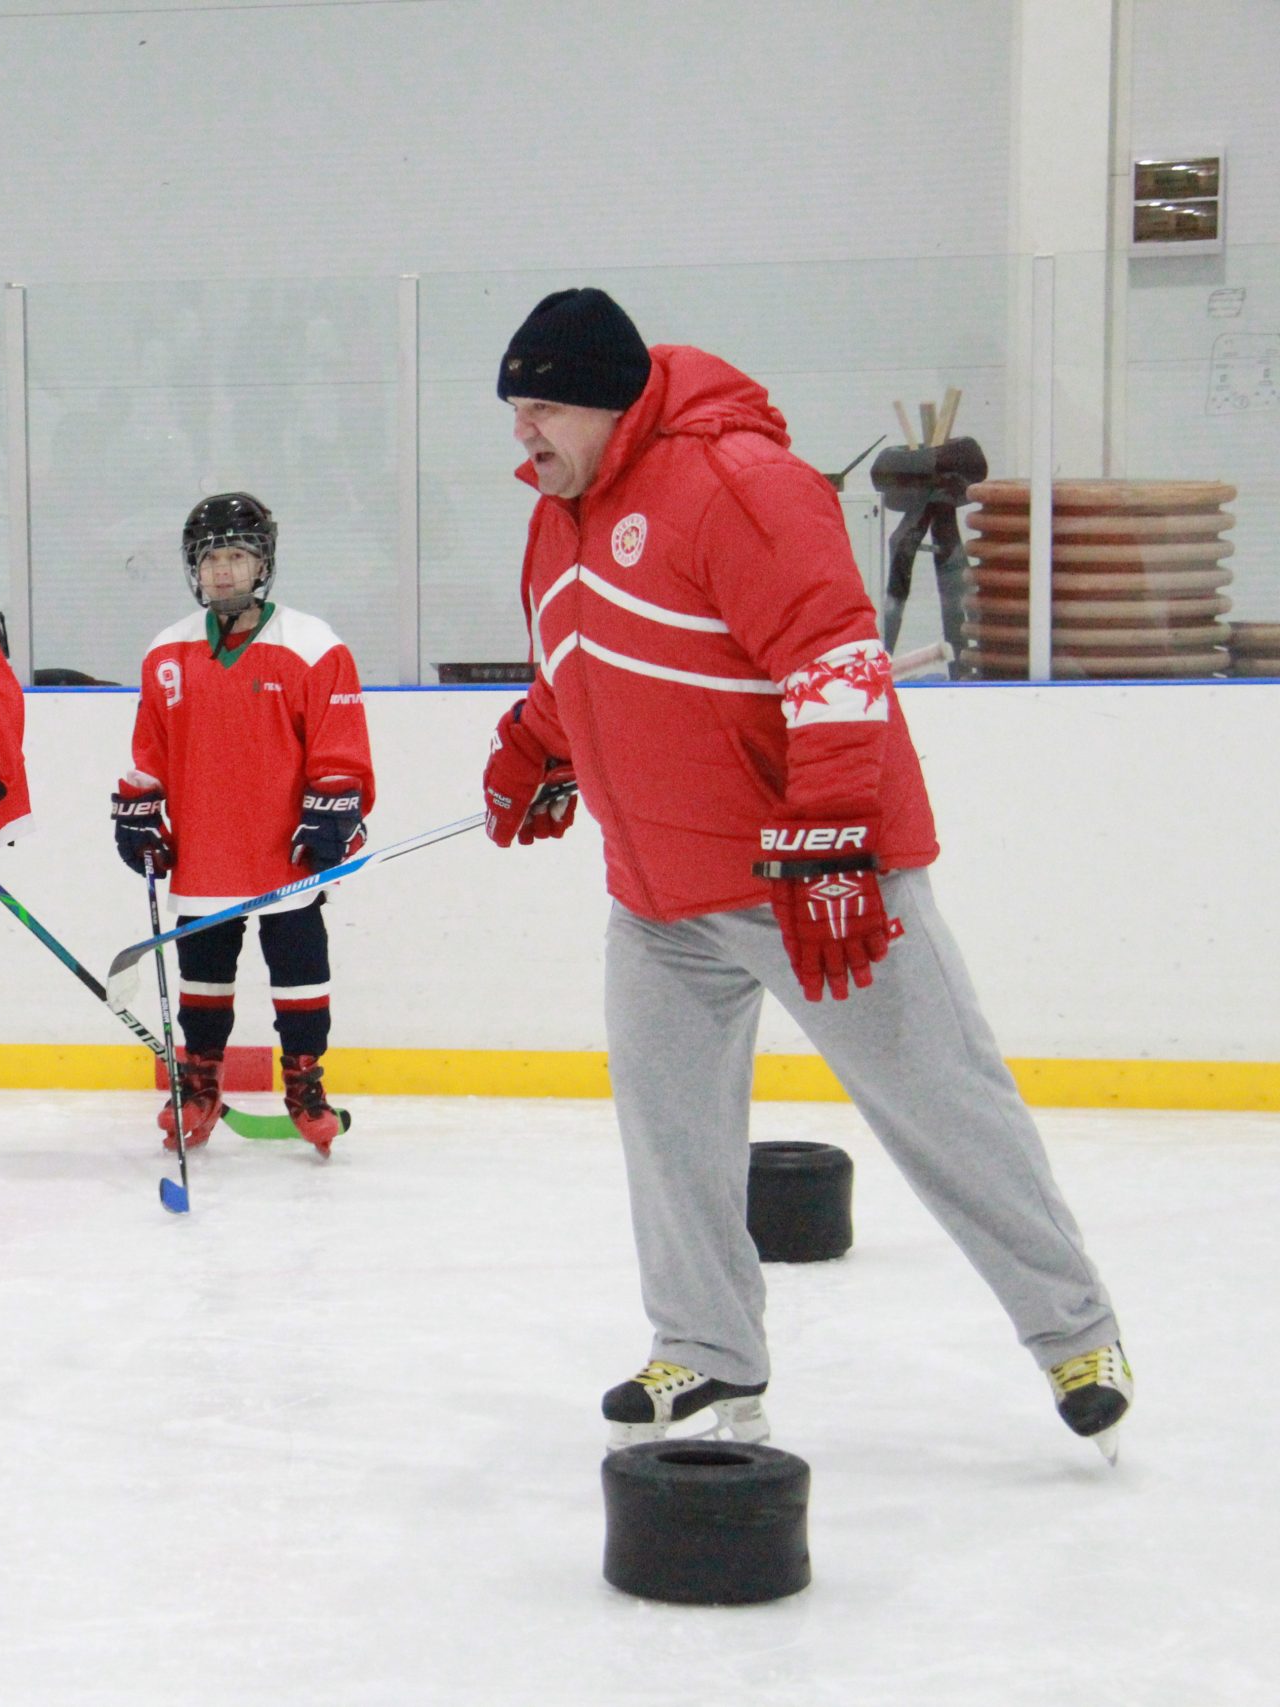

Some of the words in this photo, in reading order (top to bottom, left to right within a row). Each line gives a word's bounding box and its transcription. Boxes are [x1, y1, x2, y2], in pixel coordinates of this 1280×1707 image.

[157, 659, 182, 709] 9
[302, 795, 360, 811] AUER
[760, 825, 868, 851] AUER
